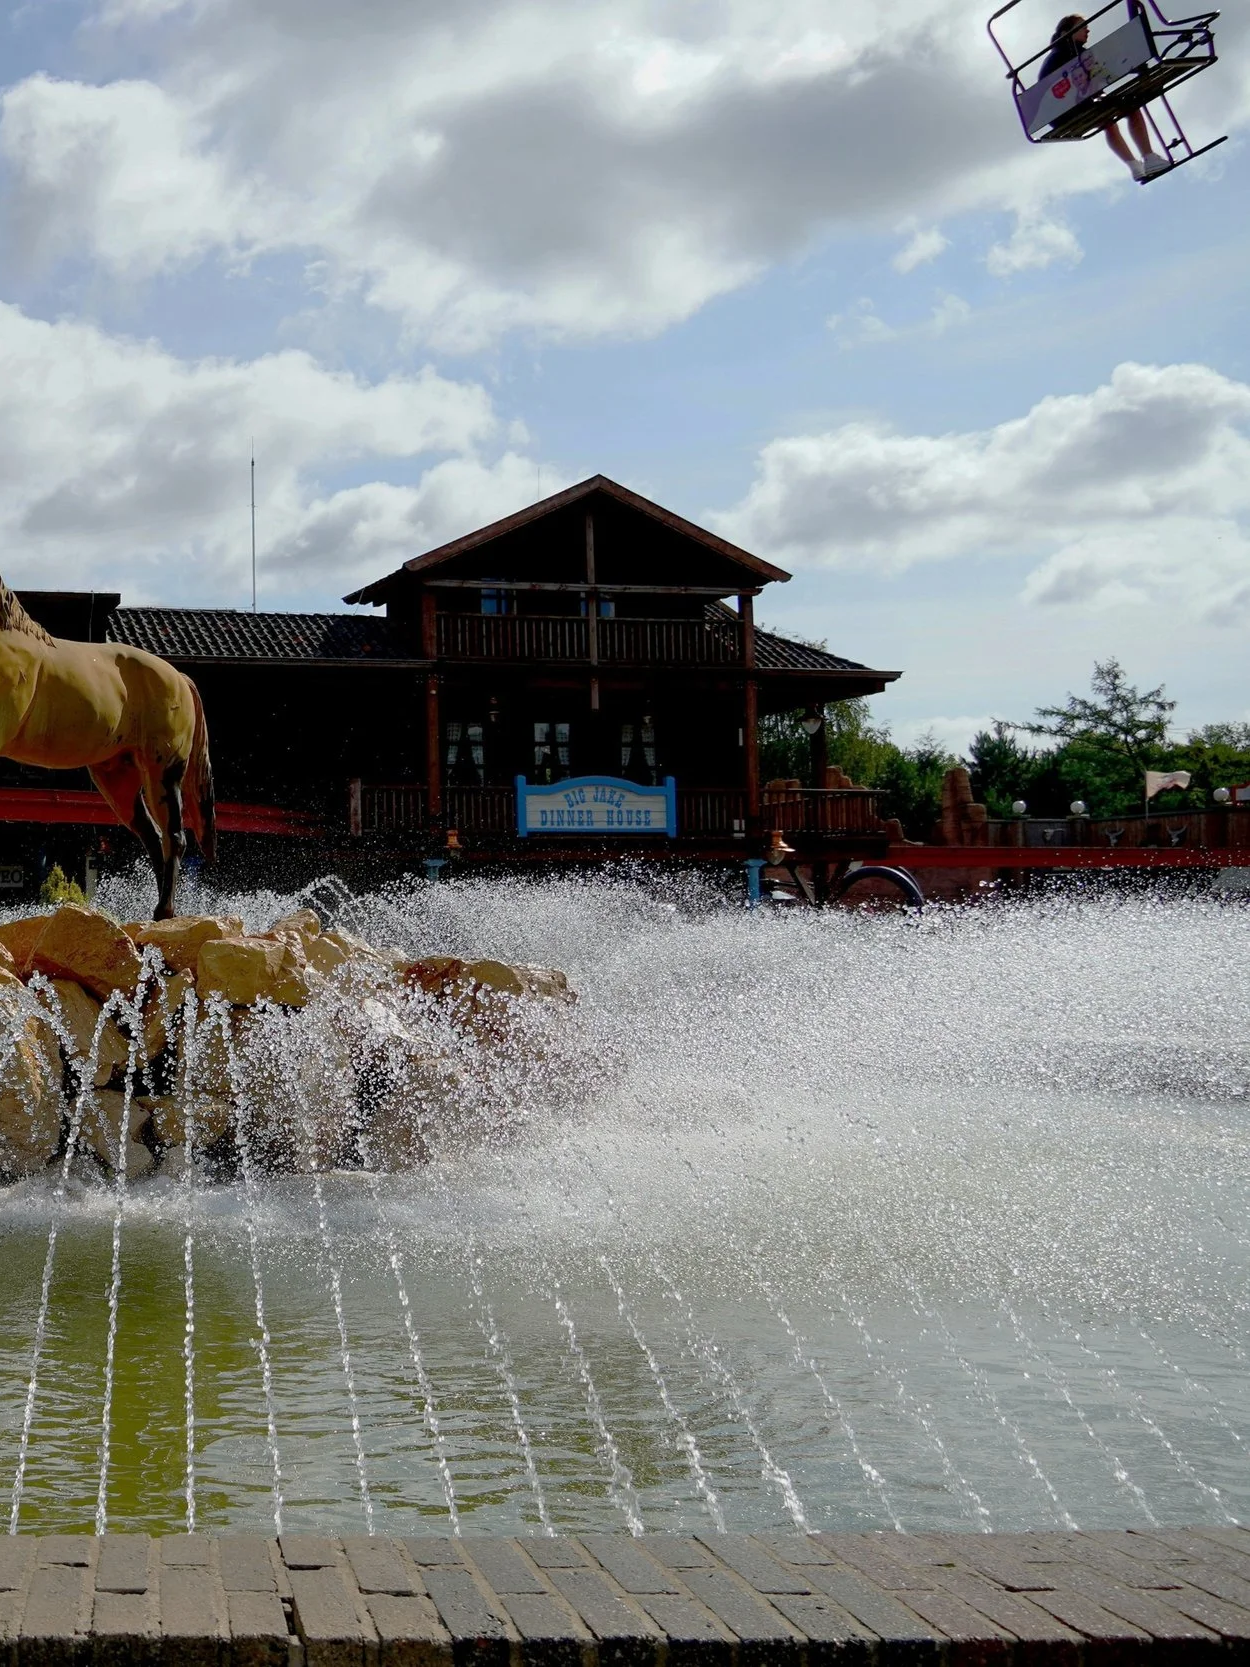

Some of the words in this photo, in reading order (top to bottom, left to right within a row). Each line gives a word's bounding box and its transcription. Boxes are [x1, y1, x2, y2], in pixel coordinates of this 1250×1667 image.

[563, 787, 586, 809] BIG
[593, 786, 625, 809] JAKE
[540, 810, 594, 826] DINNER
[606, 810, 651, 826] HOUSE
